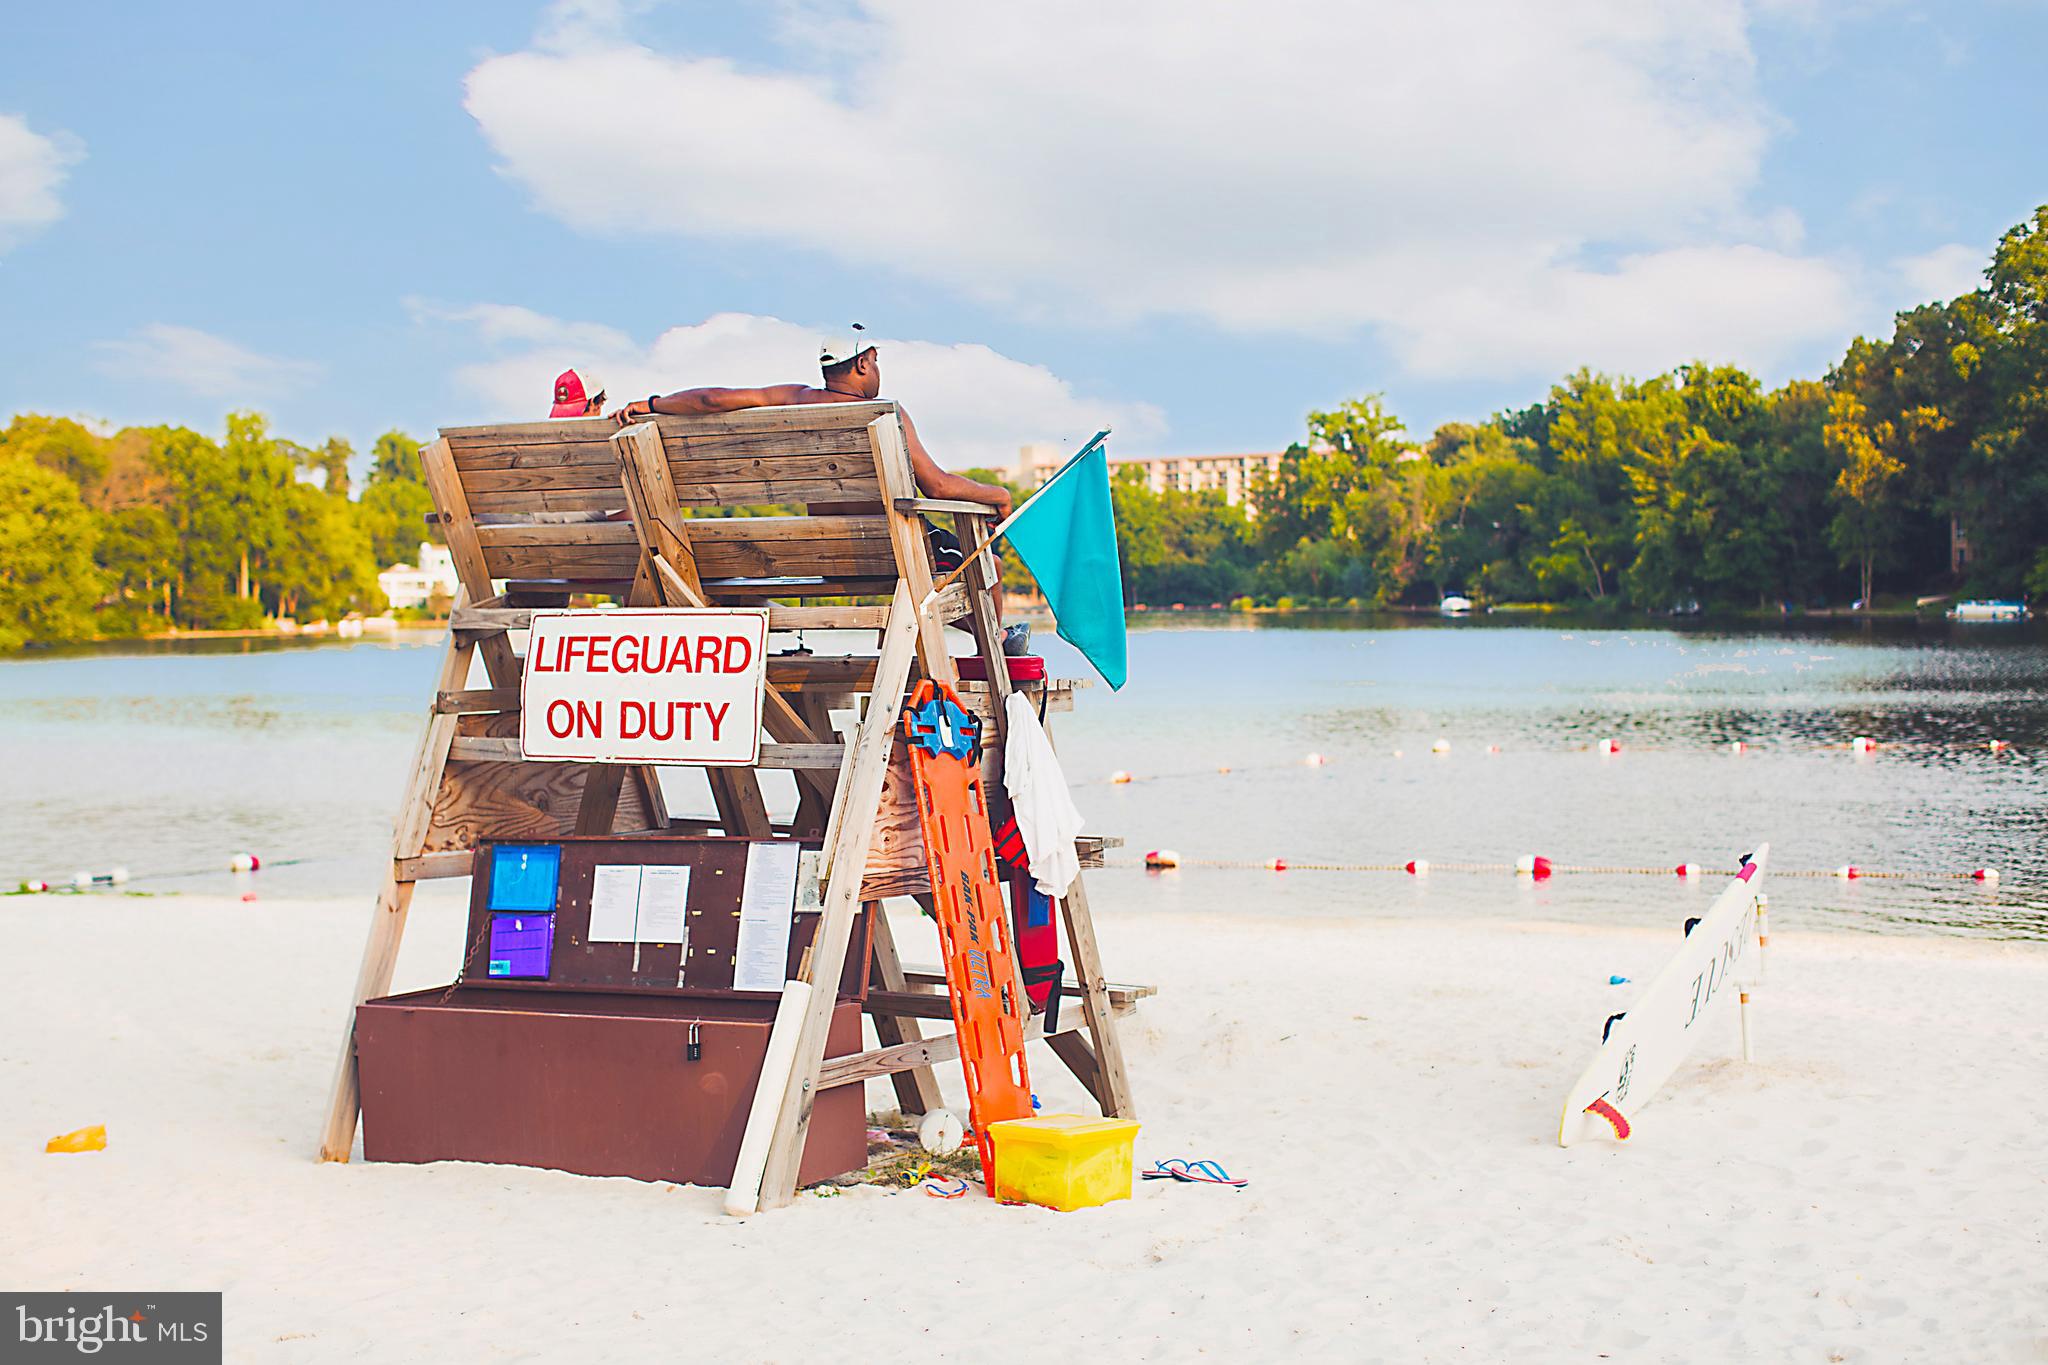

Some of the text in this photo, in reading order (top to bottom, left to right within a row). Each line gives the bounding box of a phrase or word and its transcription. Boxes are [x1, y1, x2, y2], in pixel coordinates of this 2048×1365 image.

[534, 635, 752, 674] LIFEGUARD
[546, 699, 731, 742] ON DUTY
[960, 869, 979, 944] BAK-PAK
[968, 949, 992, 999] ULTRA
